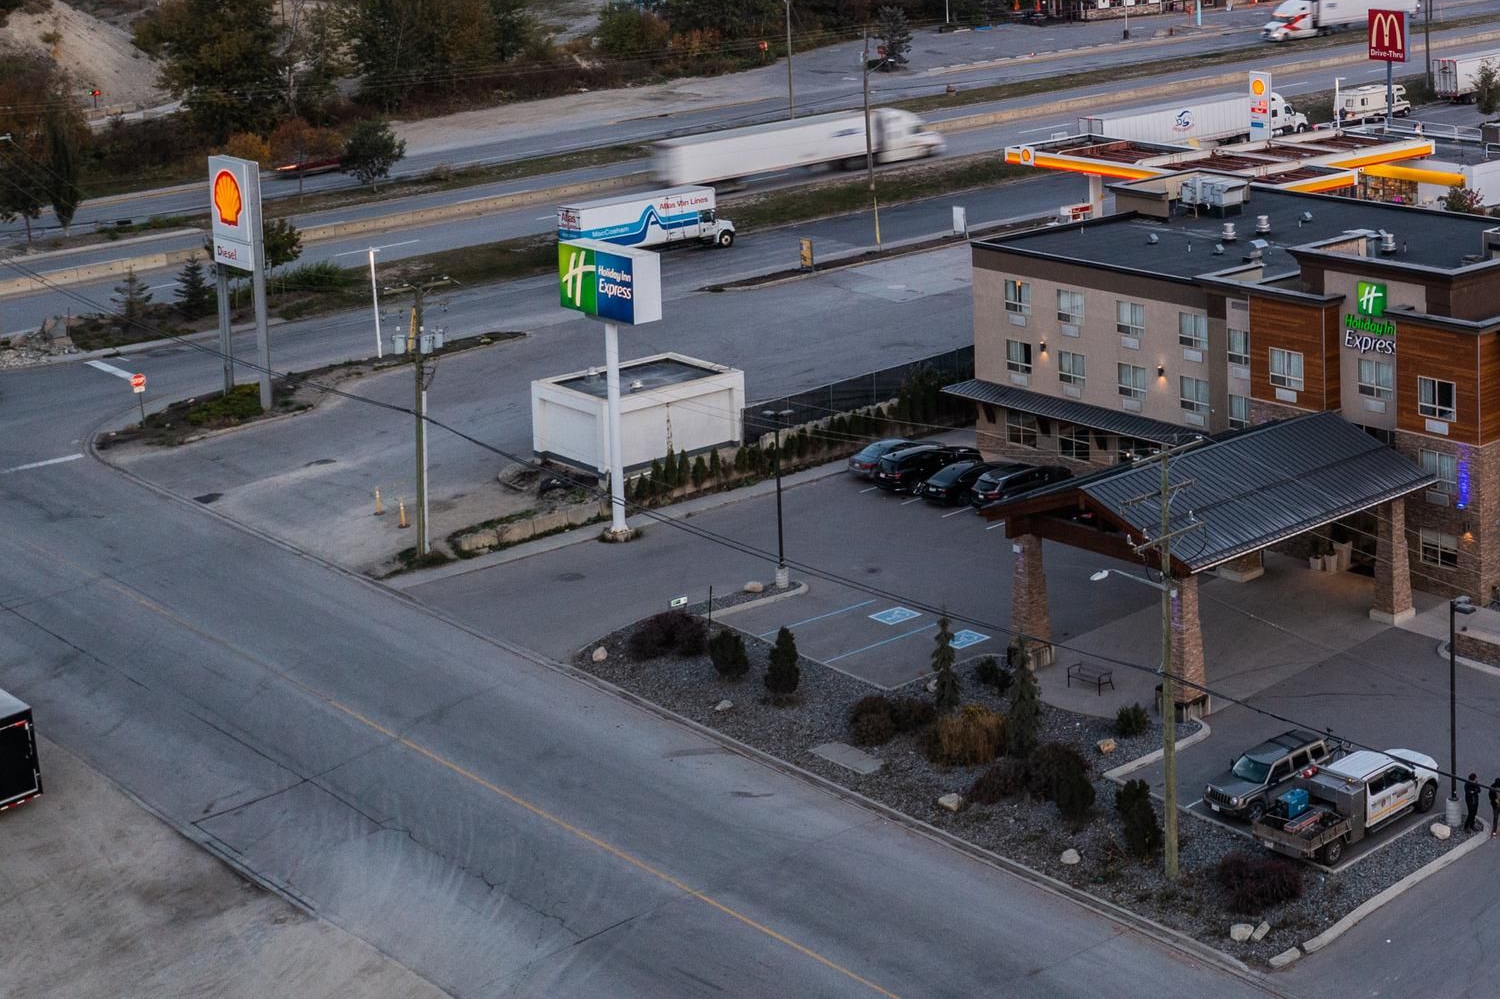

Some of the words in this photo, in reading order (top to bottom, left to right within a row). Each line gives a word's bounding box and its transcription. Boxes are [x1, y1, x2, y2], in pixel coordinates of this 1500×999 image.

[1370, 48, 1404, 59] Drive-Thru
[659, 201, 676, 210] Atlas
[690, 196, 709, 206] Lines
[217, 245, 237, 260] Diesel
[598, 265, 620, 283] Holiday
[620, 270, 632, 283] Inn
[599, 278, 632, 300] Express
[1344, 313, 1383, 336] Holiday
[1384, 320, 1396, 336] In
